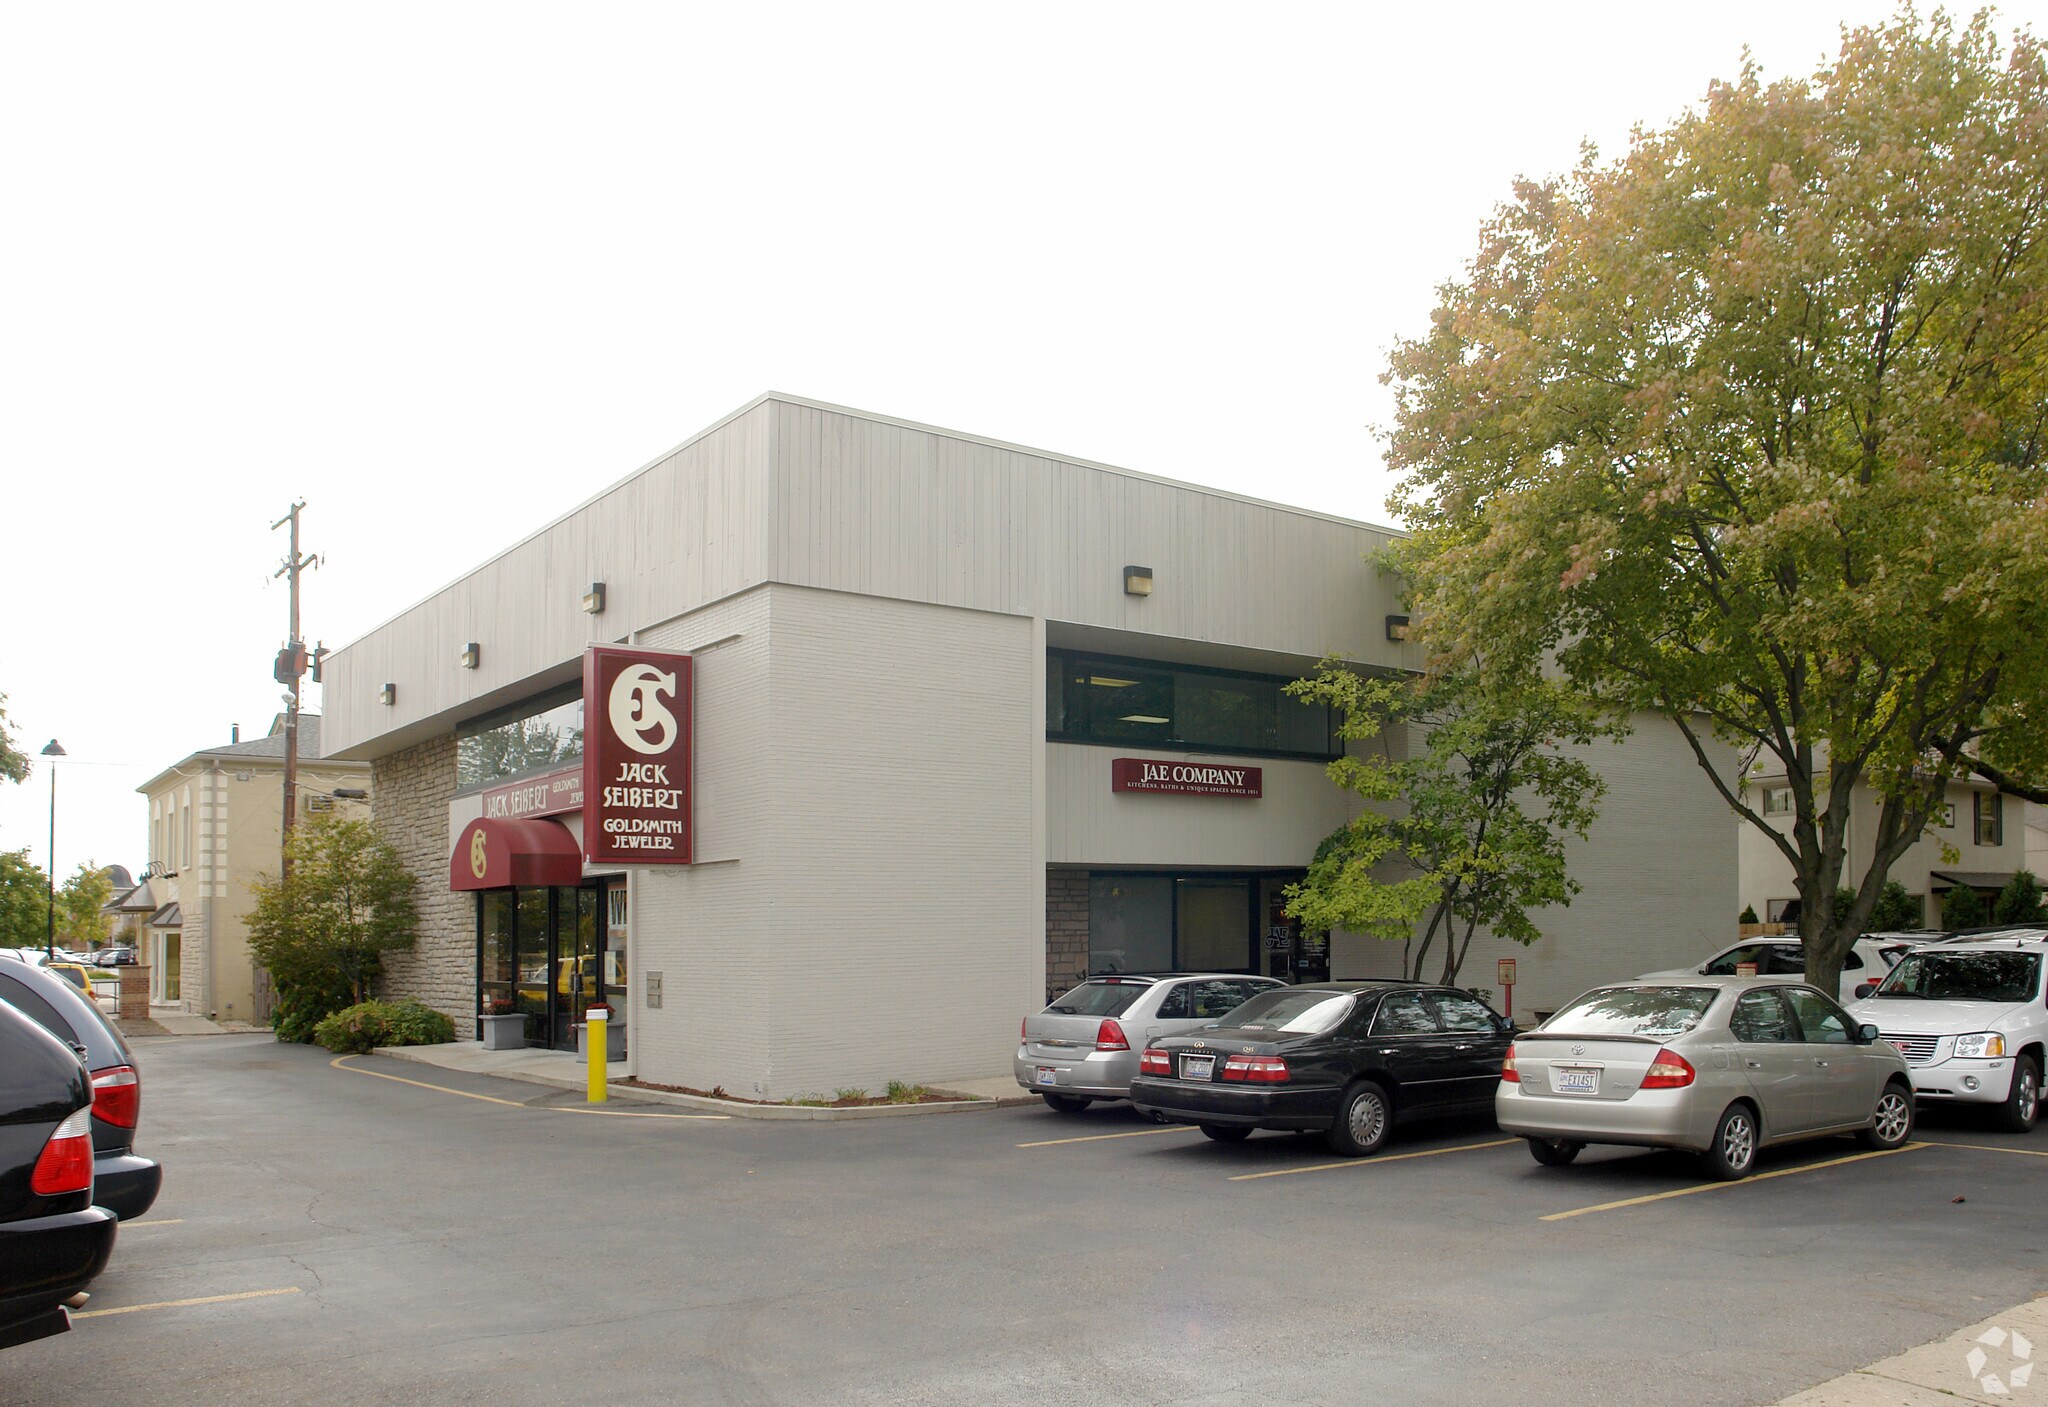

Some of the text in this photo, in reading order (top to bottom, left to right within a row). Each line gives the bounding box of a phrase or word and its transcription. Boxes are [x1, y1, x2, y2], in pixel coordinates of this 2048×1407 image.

[616, 762, 670, 786] JACK
[1141, 764, 1245, 785] JAE COMPANY
[486, 784, 549, 818] JACK SEIBERT
[603, 786, 683, 810] SEIBERT
[603, 818, 682, 834] GOLDSMITH
[612, 835, 675, 850] JEWELER
